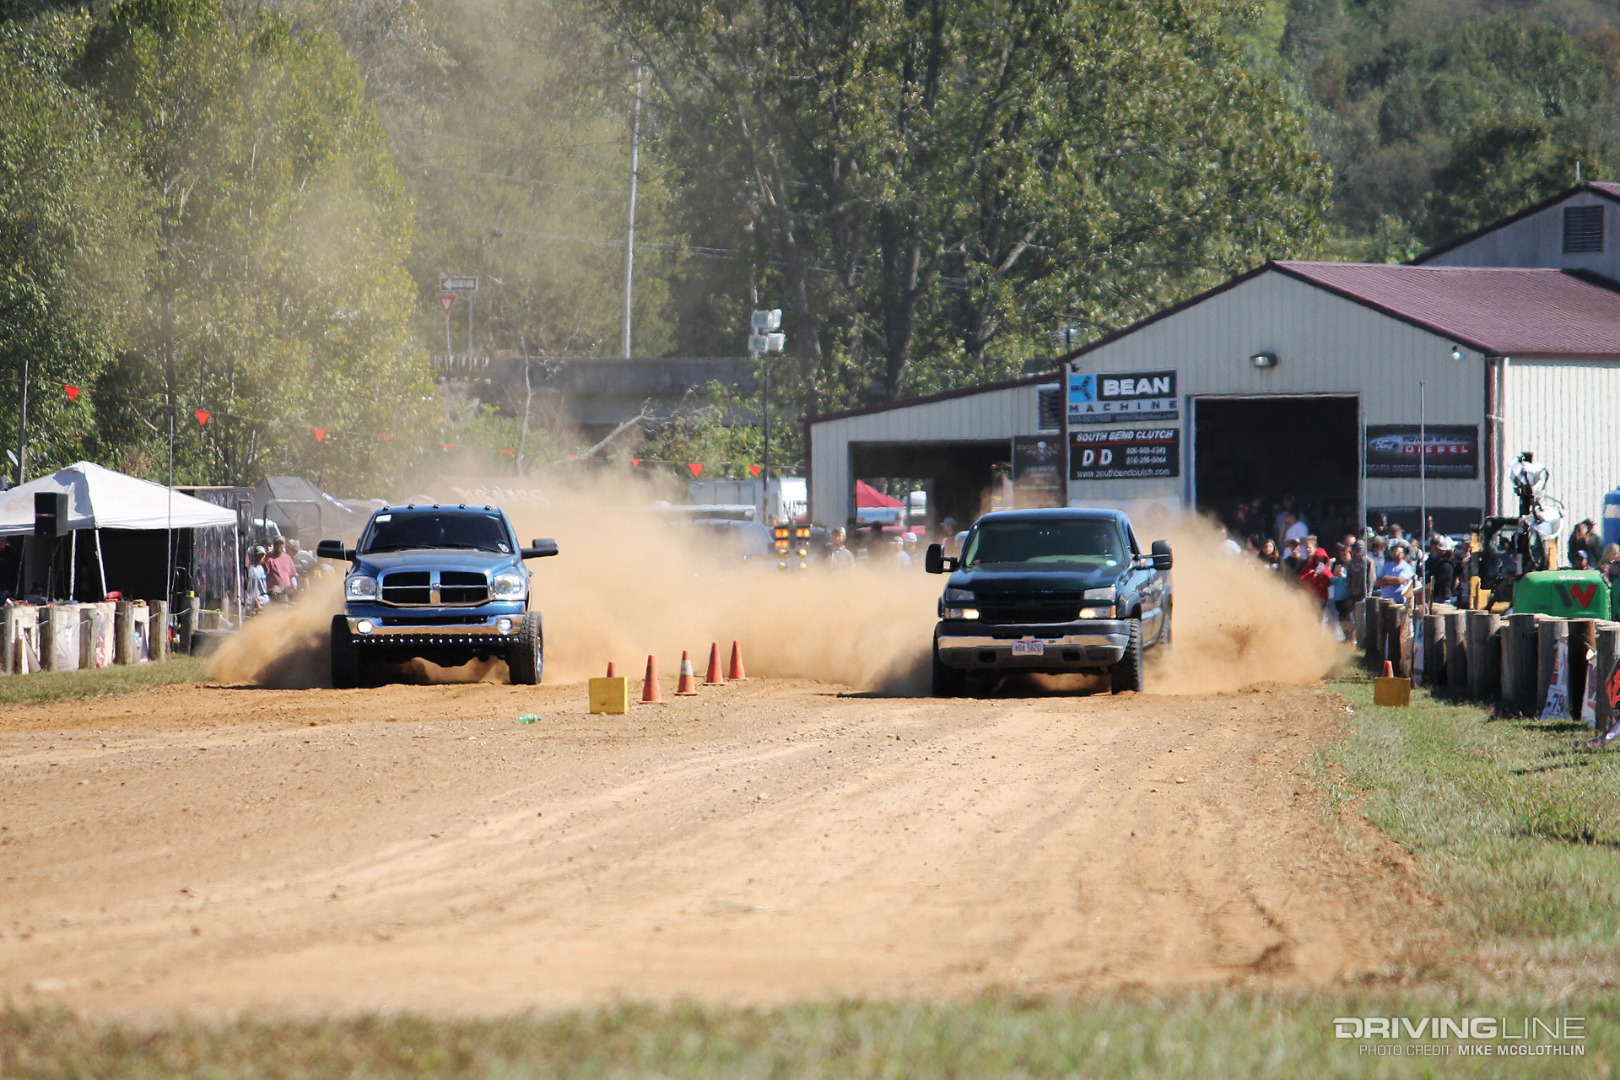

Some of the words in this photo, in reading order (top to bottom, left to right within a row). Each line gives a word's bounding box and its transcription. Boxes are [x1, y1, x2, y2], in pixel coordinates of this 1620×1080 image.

[1103, 376, 1170, 396] BEAN
[1069, 400, 1177, 413] MACHINE
[1076, 431, 1107, 442] SOUTH
[1109, 430, 1134, 440] BEND
[1136, 429, 1174, 439] CLUTCH
[1405, 445, 1469, 454] DIESEL
